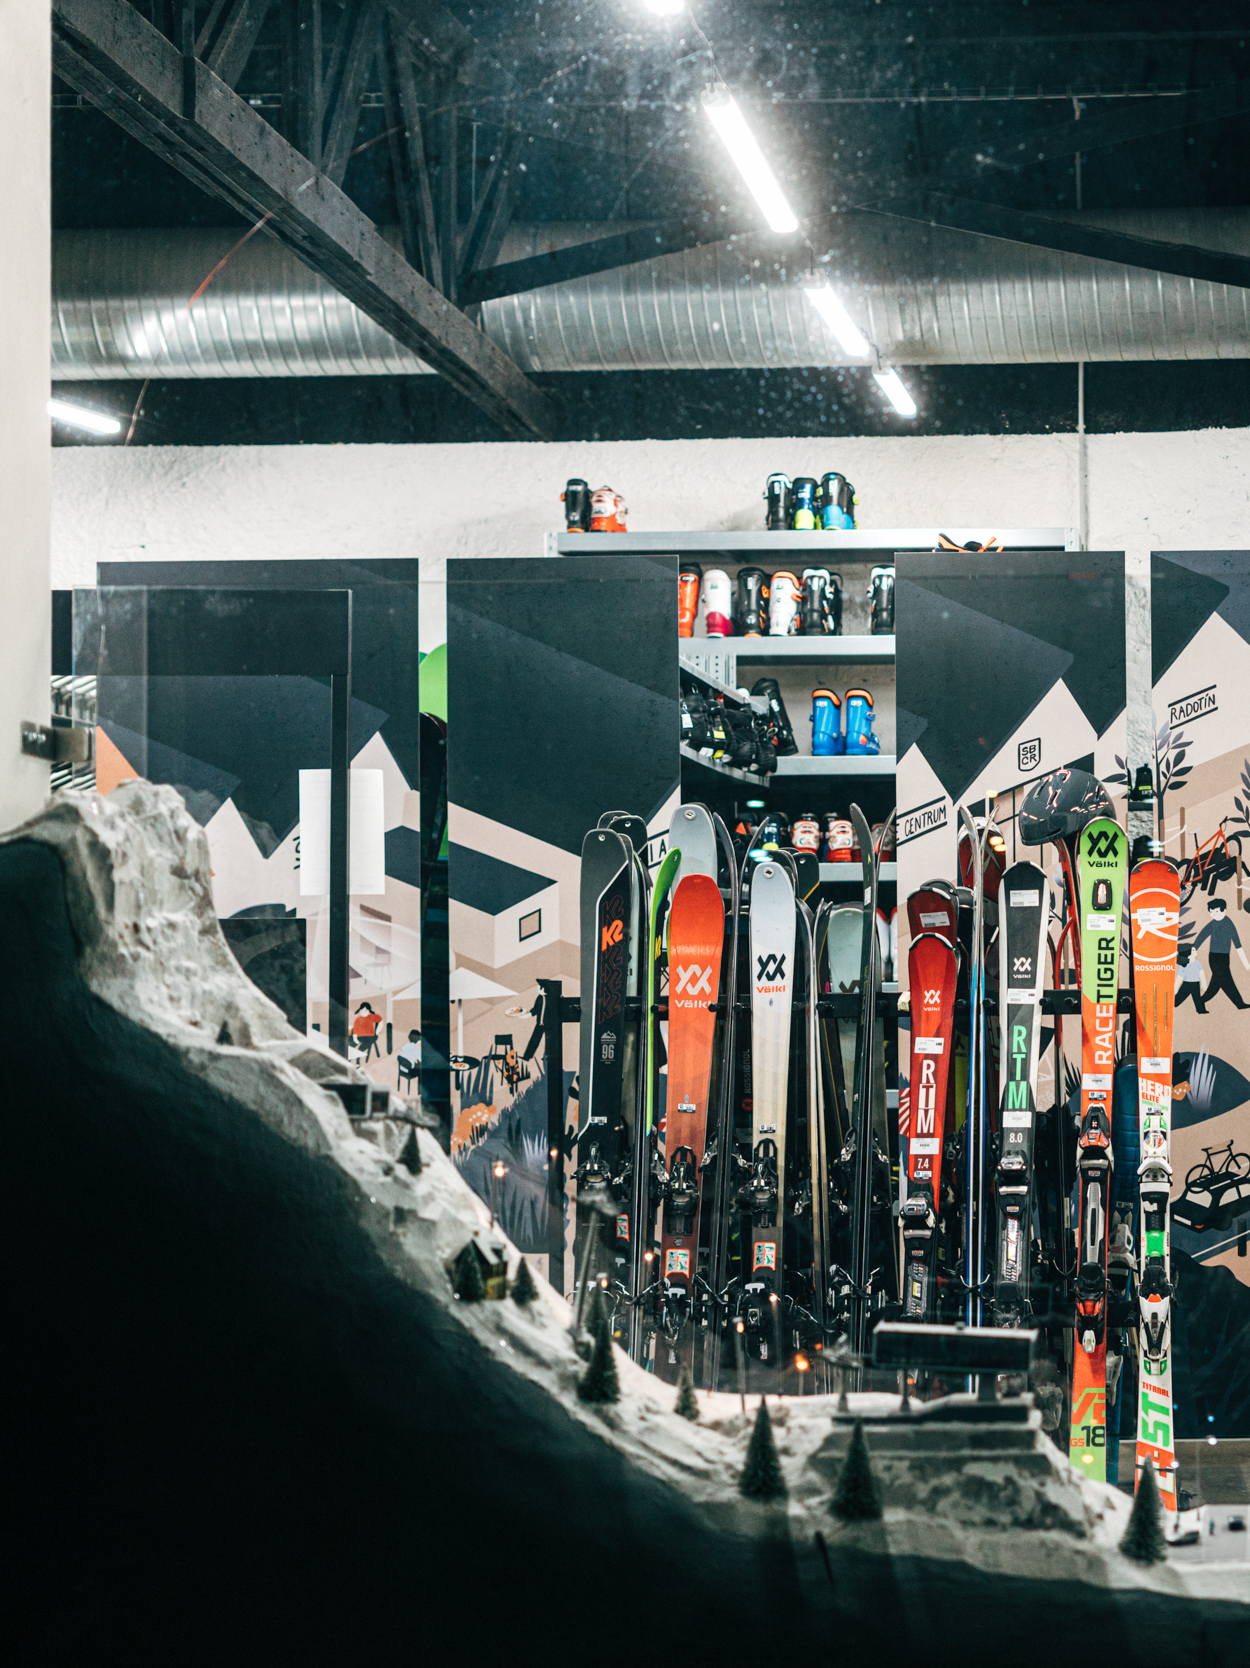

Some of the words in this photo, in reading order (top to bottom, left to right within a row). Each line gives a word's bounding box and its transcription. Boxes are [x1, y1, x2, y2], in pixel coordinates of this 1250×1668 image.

[1170, 693, 1215, 724] RADOTÍN
[1022, 745, 1036, 756] SB
[1022, 754, 1038, 765] CR
[905, 805, 946, 836] CENTRUM
[1088, 860, 1118, 868] Völkl
[601, 919, 624, 952] K2
[756, 985, 786, 993] Völkl
[602, 1044, 615, 1060] 96
[1142, 1092, 1160, 1104] ELITE
[1009, 1133, 1023, 1143] 8.0
[917, 1158, 929, 1169] 7.4
[1142, 1381, 1170, 1397] TITANAL
[1070, 1438, 1085, 1447] GS
[1081, 1426, 1105, 1447] 18
